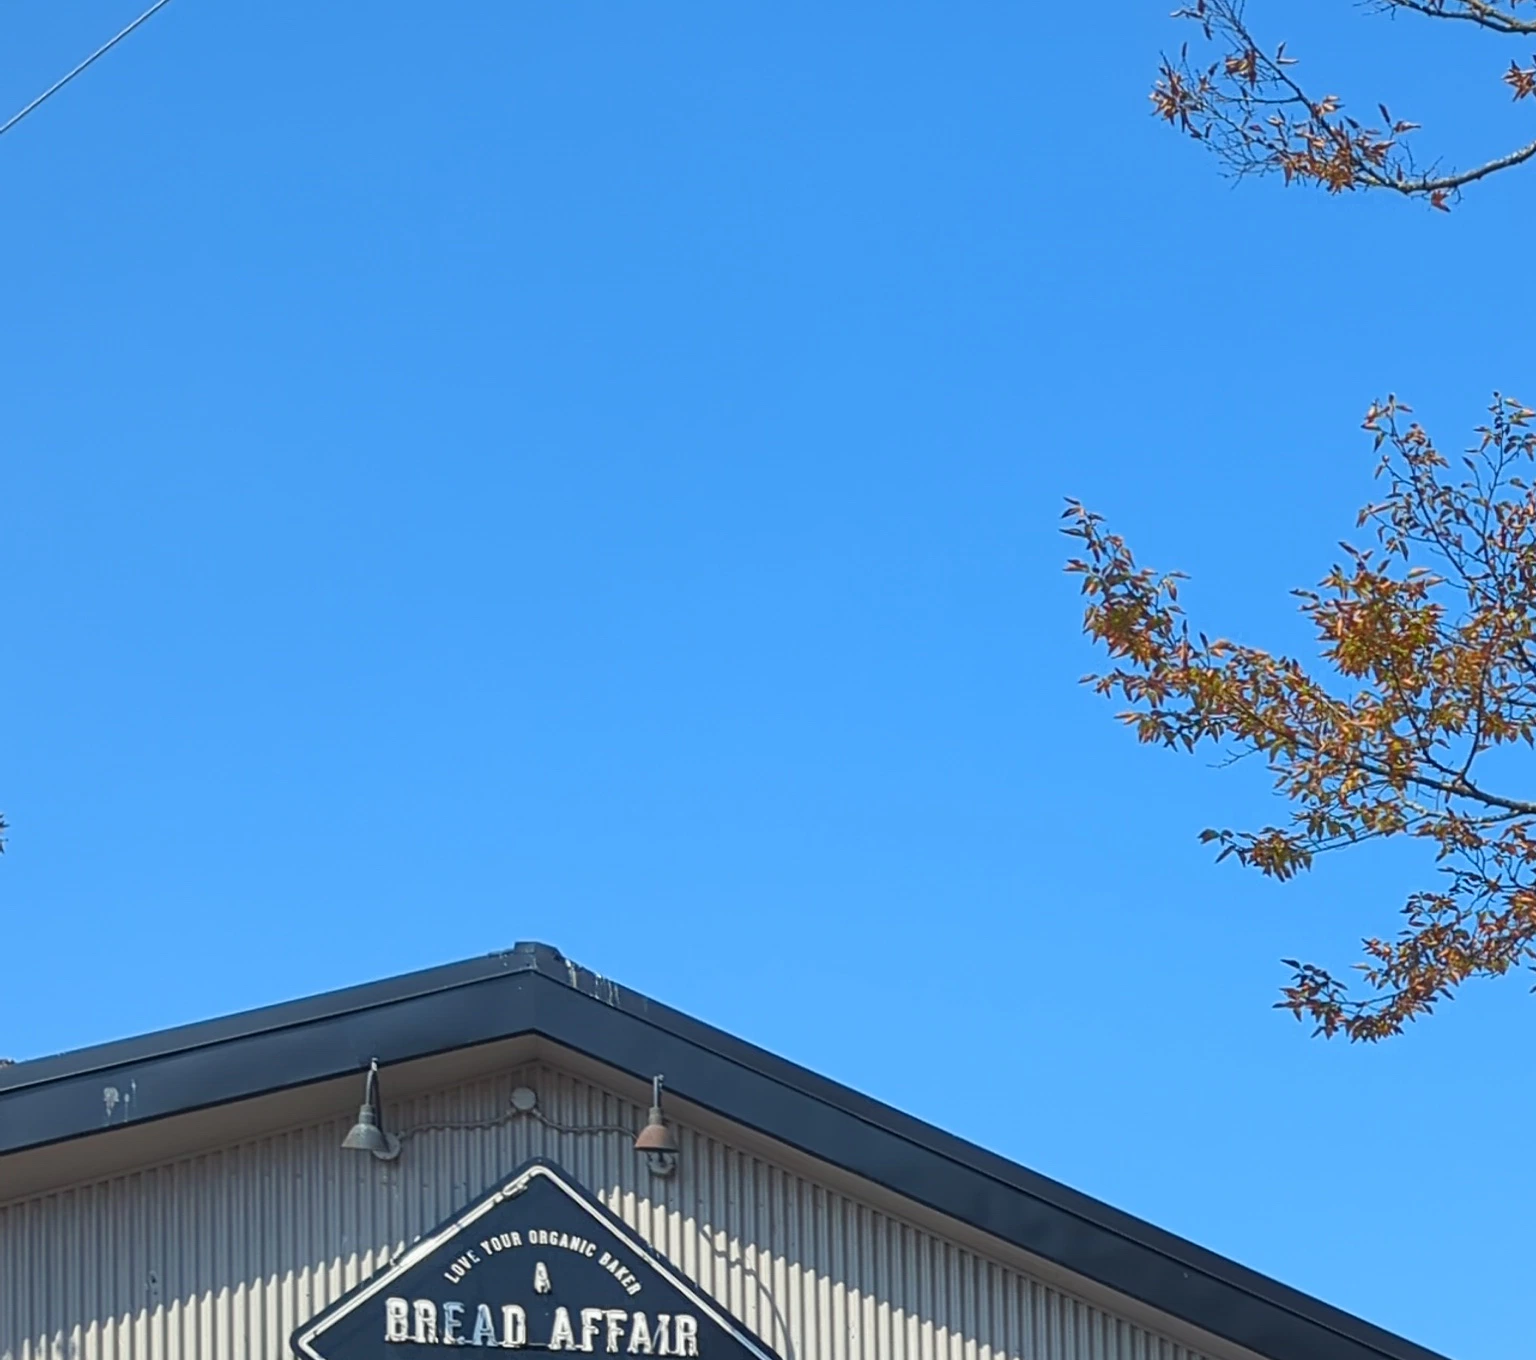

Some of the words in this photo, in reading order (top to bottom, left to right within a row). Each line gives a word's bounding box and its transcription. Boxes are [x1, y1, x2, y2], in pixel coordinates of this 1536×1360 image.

[444, 1249, 481, 1284] LOVE
[480, 1231, 522, 1255] YOUR
[528, 1230, 597, 1257] ORGANIC
[598, 1252, 642, 1295] BAKER
[534, 1262, 551, 1294] A
[385, 1298, 526, 1346] BREAD
[550, 1307, 698, 1357] AFFAIR
